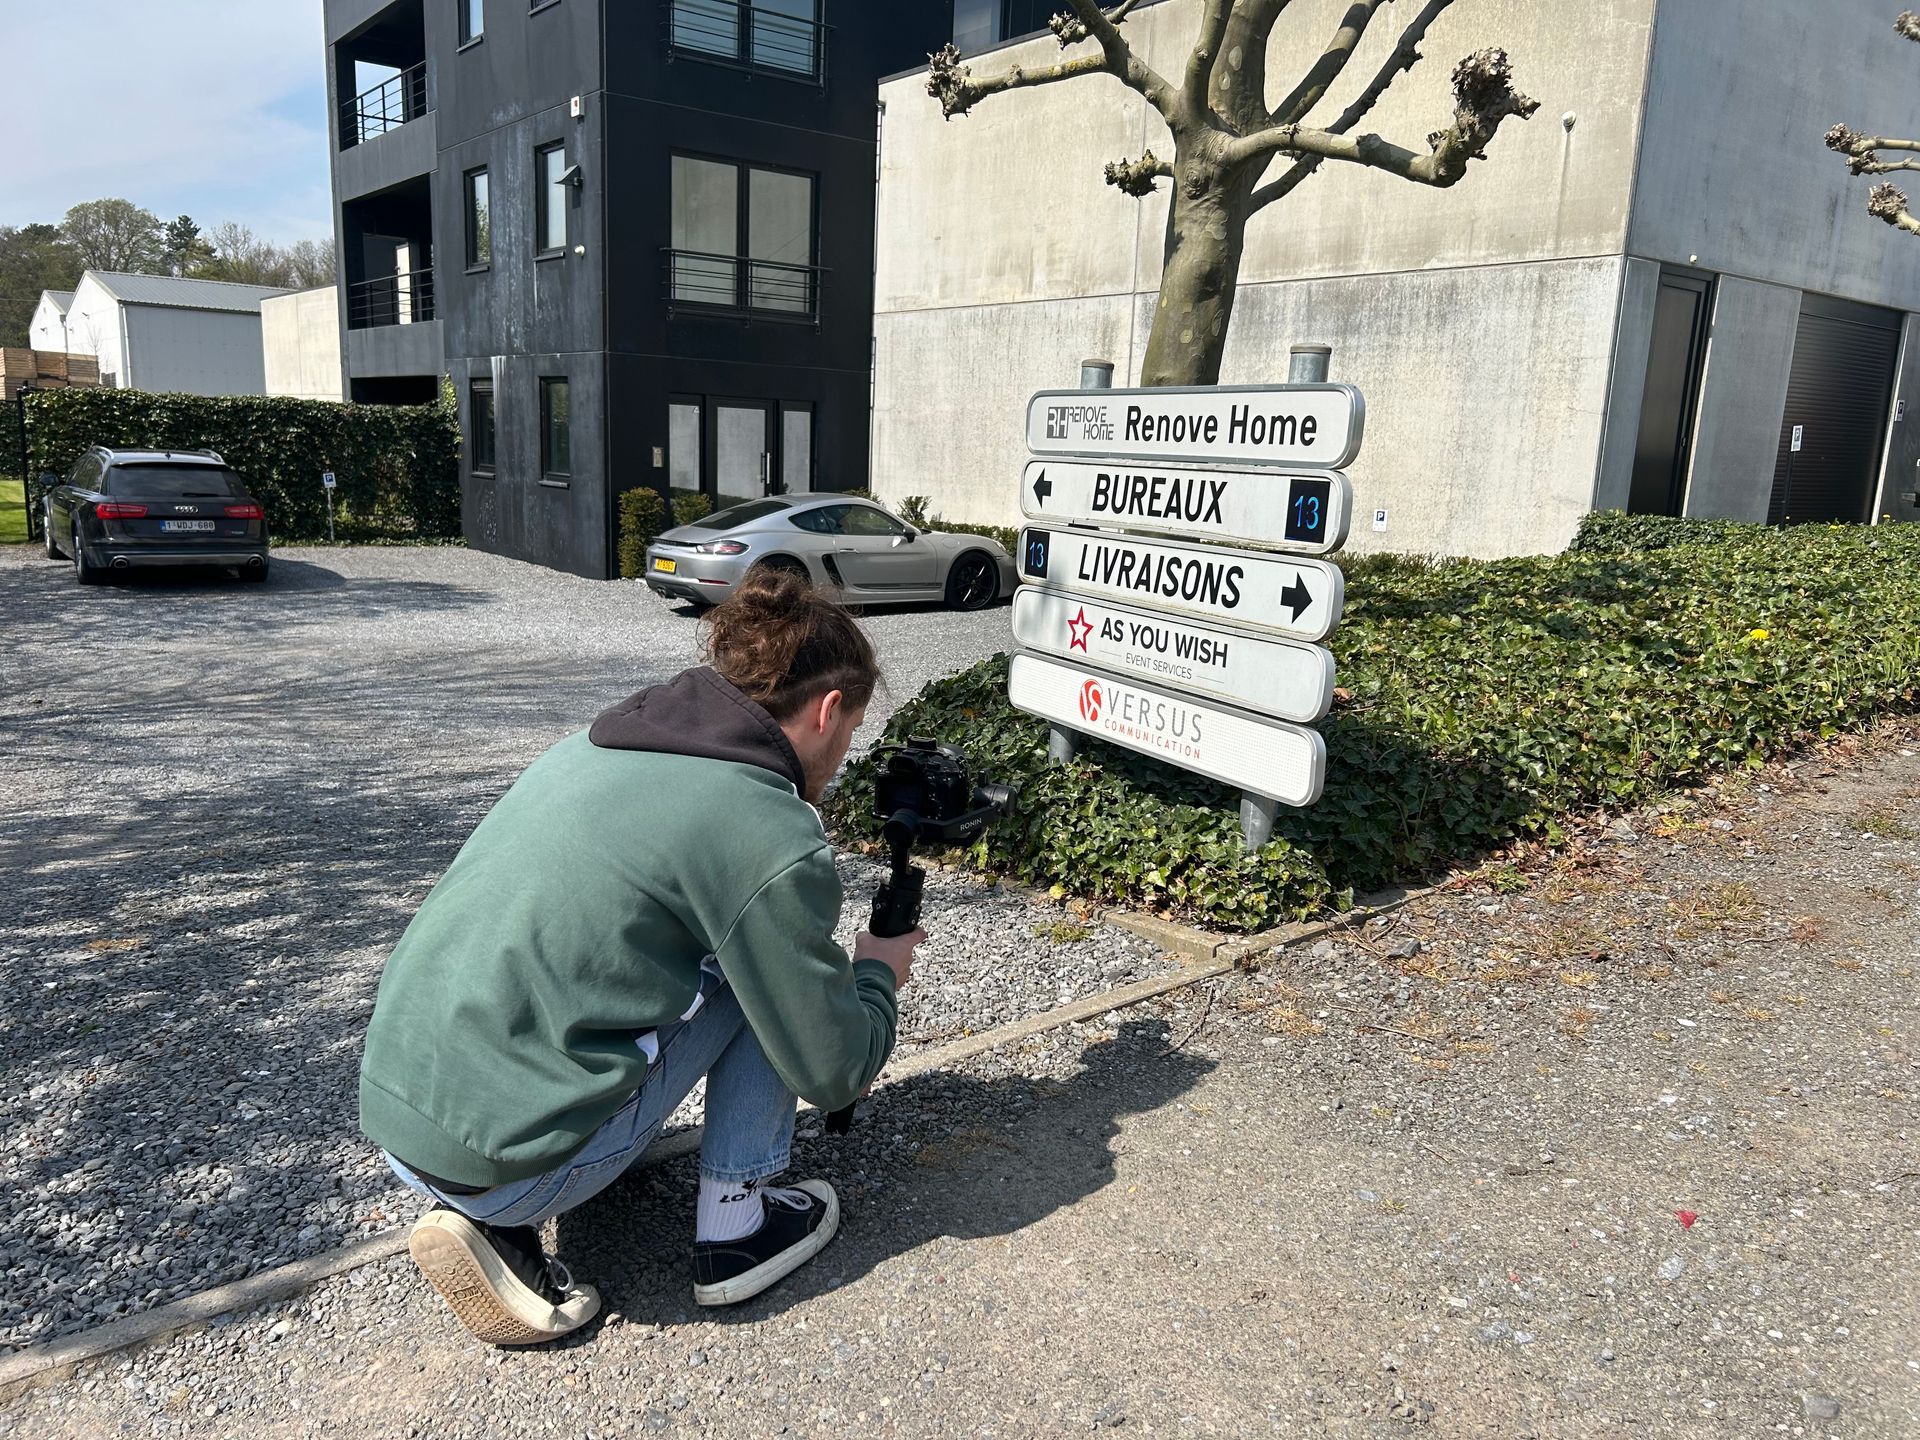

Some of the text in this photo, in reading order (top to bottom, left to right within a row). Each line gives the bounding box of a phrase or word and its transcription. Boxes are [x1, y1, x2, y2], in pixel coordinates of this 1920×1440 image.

[1124, 404, 1317, 446] Renove Home
[1092, 473, 1228, 524] BUREAUX
[1294, 495, 1320, 530] 13
[1029, 543, 1044, 568] 13
[1078, 544, 1244, 608] LIVRAISONS
[1100, 617, 1228, 668] AS YOU WISH
[1126, 652, 1192, 680] EVENT SERVICES
[1107, 687, 1202, 743] VERSUS
[1104, 718, 1201, 759] COMMUNICATION
[960, 817, 982, 831] RONIN
